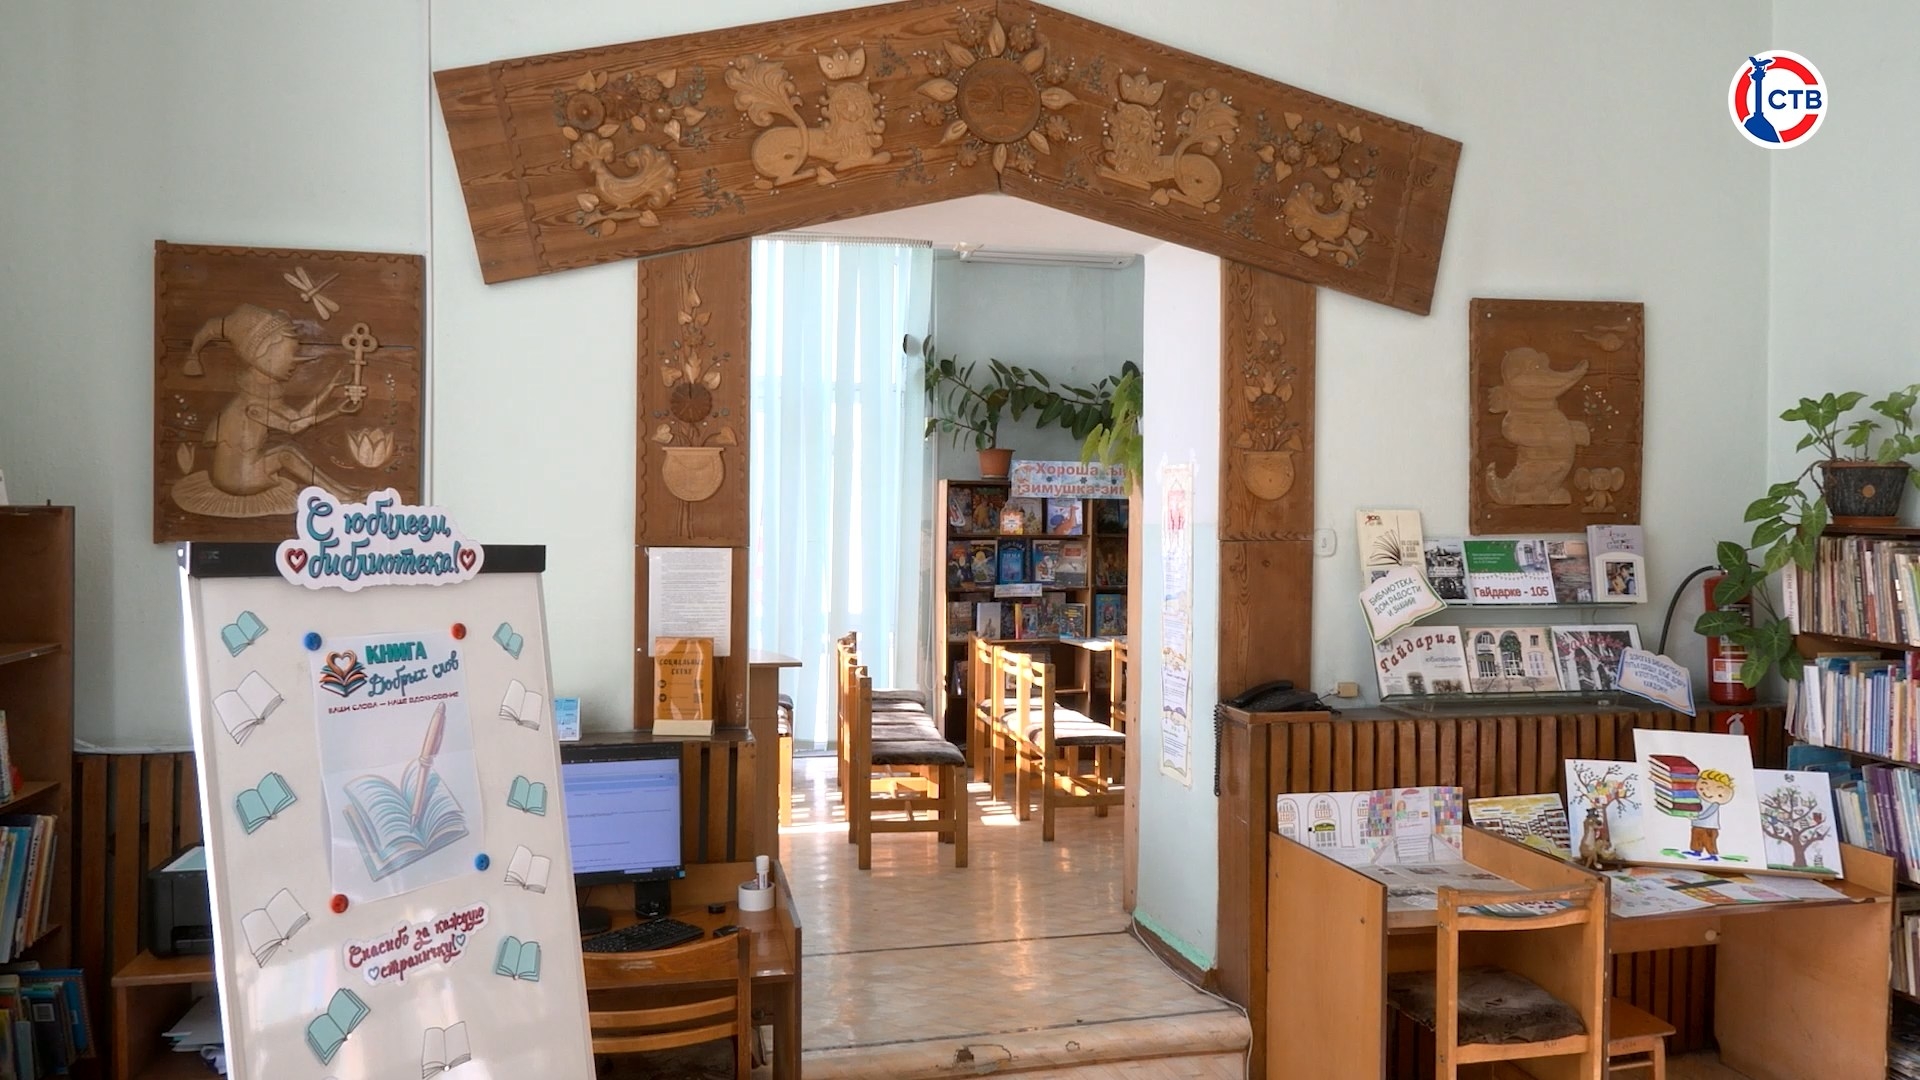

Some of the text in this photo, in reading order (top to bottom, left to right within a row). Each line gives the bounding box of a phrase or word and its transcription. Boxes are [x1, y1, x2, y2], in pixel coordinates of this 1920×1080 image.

[1036, 462, 1099, 477] Хороша
[1022, 484, 1125, 497] зимушка-зи
[306, 496, 451, 542] С юбилеем,
[308, 537, 461, 581] библиотека!
[1369, 577, 1413, 606] БИБЛИОТЕКА
[1374, 585, 1422, 615] ДОМ РАДОСТИ
[1473, 586, 1521, 599] Гайдарке
[1530, 586, 1549, 597] 105
[1387, 609, 1394, 617] И
[365, 641, 427, 664] КНИГА
[1380, 633, 1457, 673] Гайдария
[368, 650, 459, 697] Добрых слов
[328, 705, 351, 715] ВАШИ
[352, 702, 378, 712] СЛОВА
[387, 698, 408, 707] НАШЕ
[409, 691, 459, 704] ВДОХНОВЕНИЕ
[349, 906, 484, 968] Спасибо за каждую
[380, 934, 461, 980] страничку!
